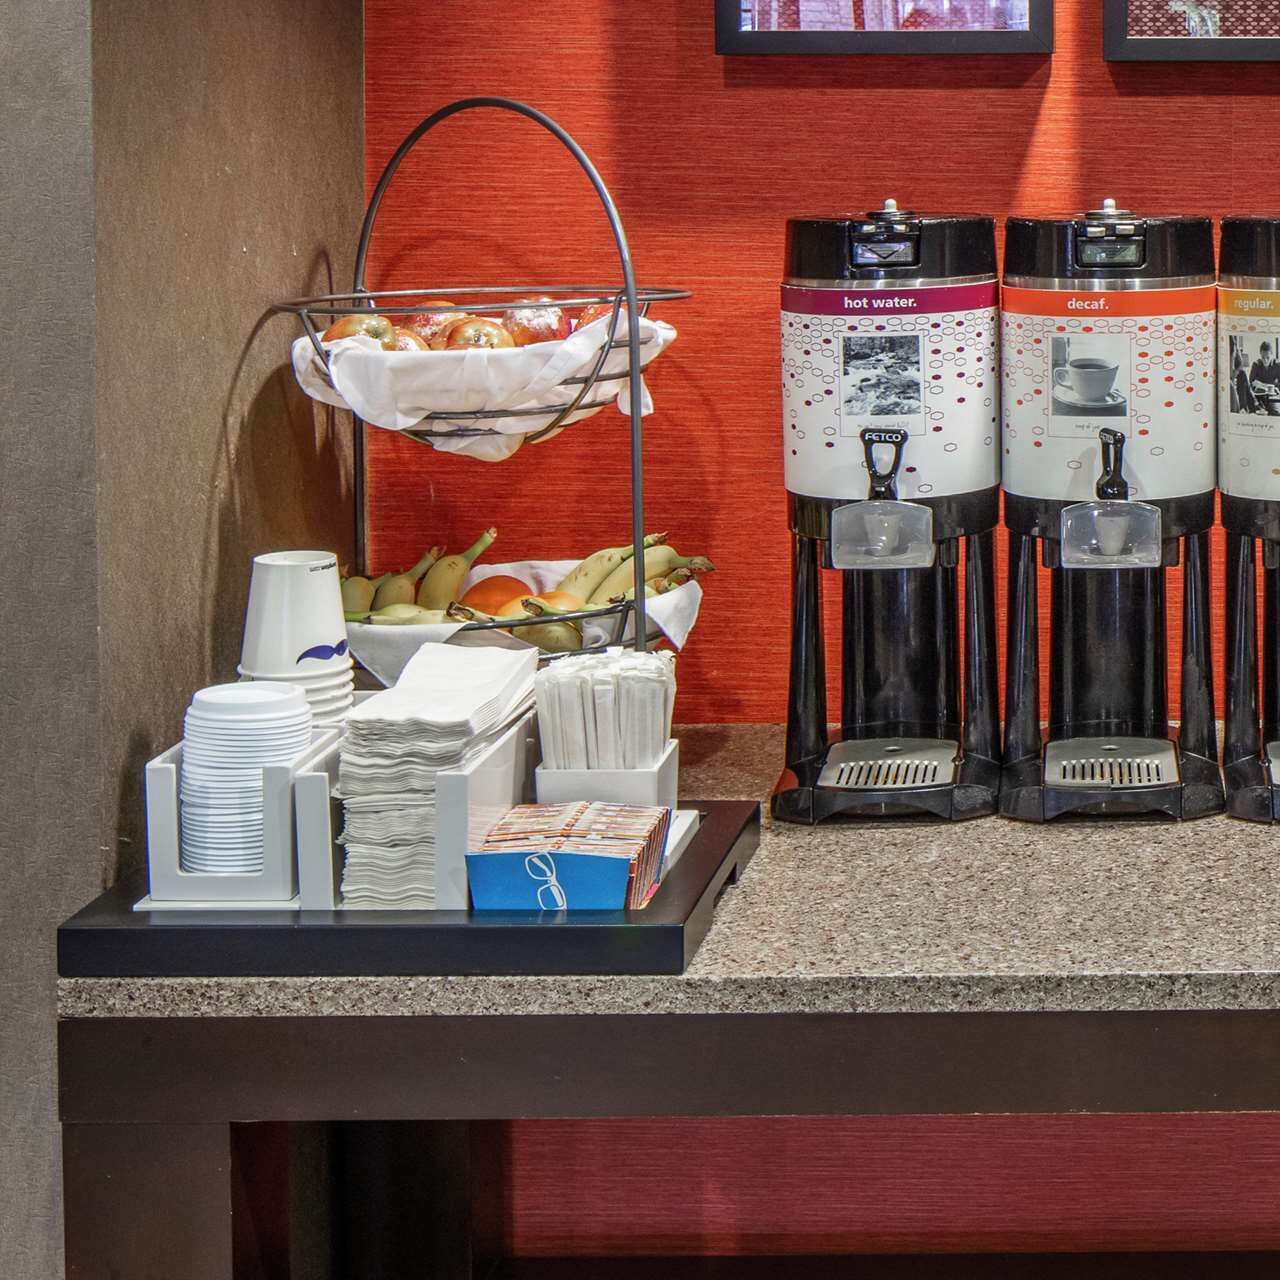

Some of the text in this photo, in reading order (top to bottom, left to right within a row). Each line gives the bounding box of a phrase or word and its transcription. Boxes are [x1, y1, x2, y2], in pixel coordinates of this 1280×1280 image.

[844, 296, 917, 308] hot water.
[1067, 297, 1109, 310] decaf.
[1234, 297, 1274, 311] regular.
[865, 432, 901, 442] FETCO
